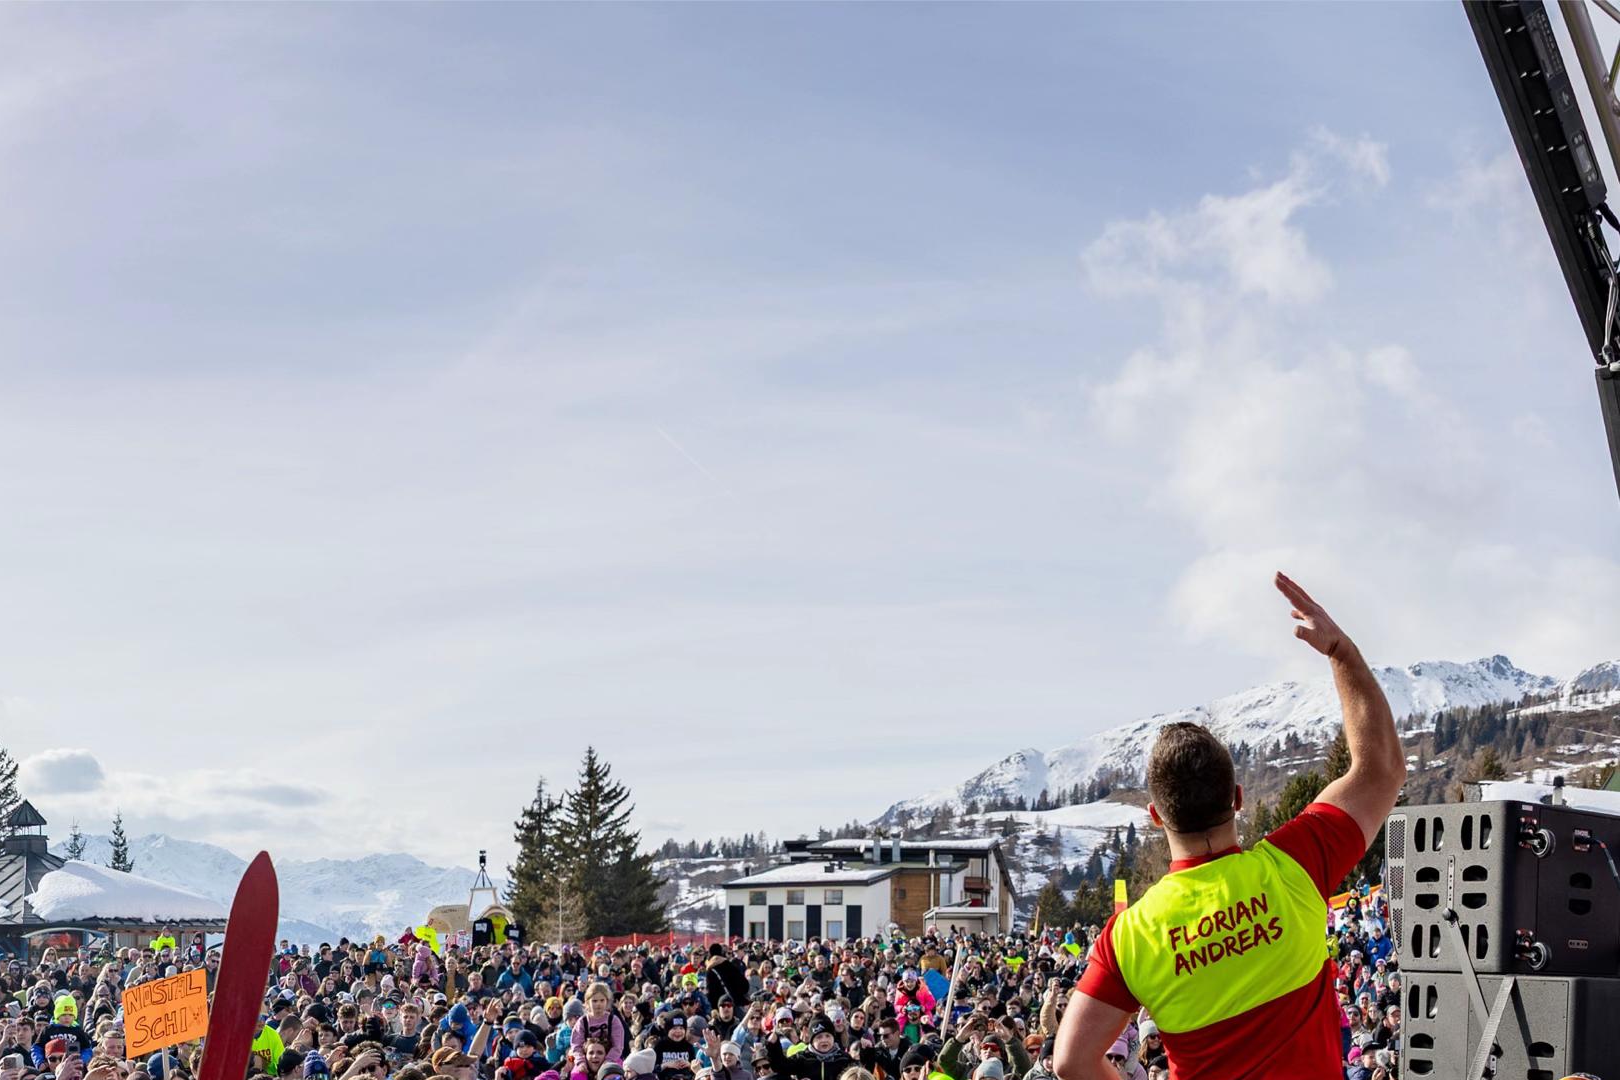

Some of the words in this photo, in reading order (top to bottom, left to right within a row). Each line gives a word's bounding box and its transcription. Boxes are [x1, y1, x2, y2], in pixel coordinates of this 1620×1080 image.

[1168, 891, 1270, 952] FLORIAN
[1173, 915, 1284, 978] ANDREAS
[124, 974, 202, 1016] NOSTAL
[131, 1007, 188, 1049] SCHI
